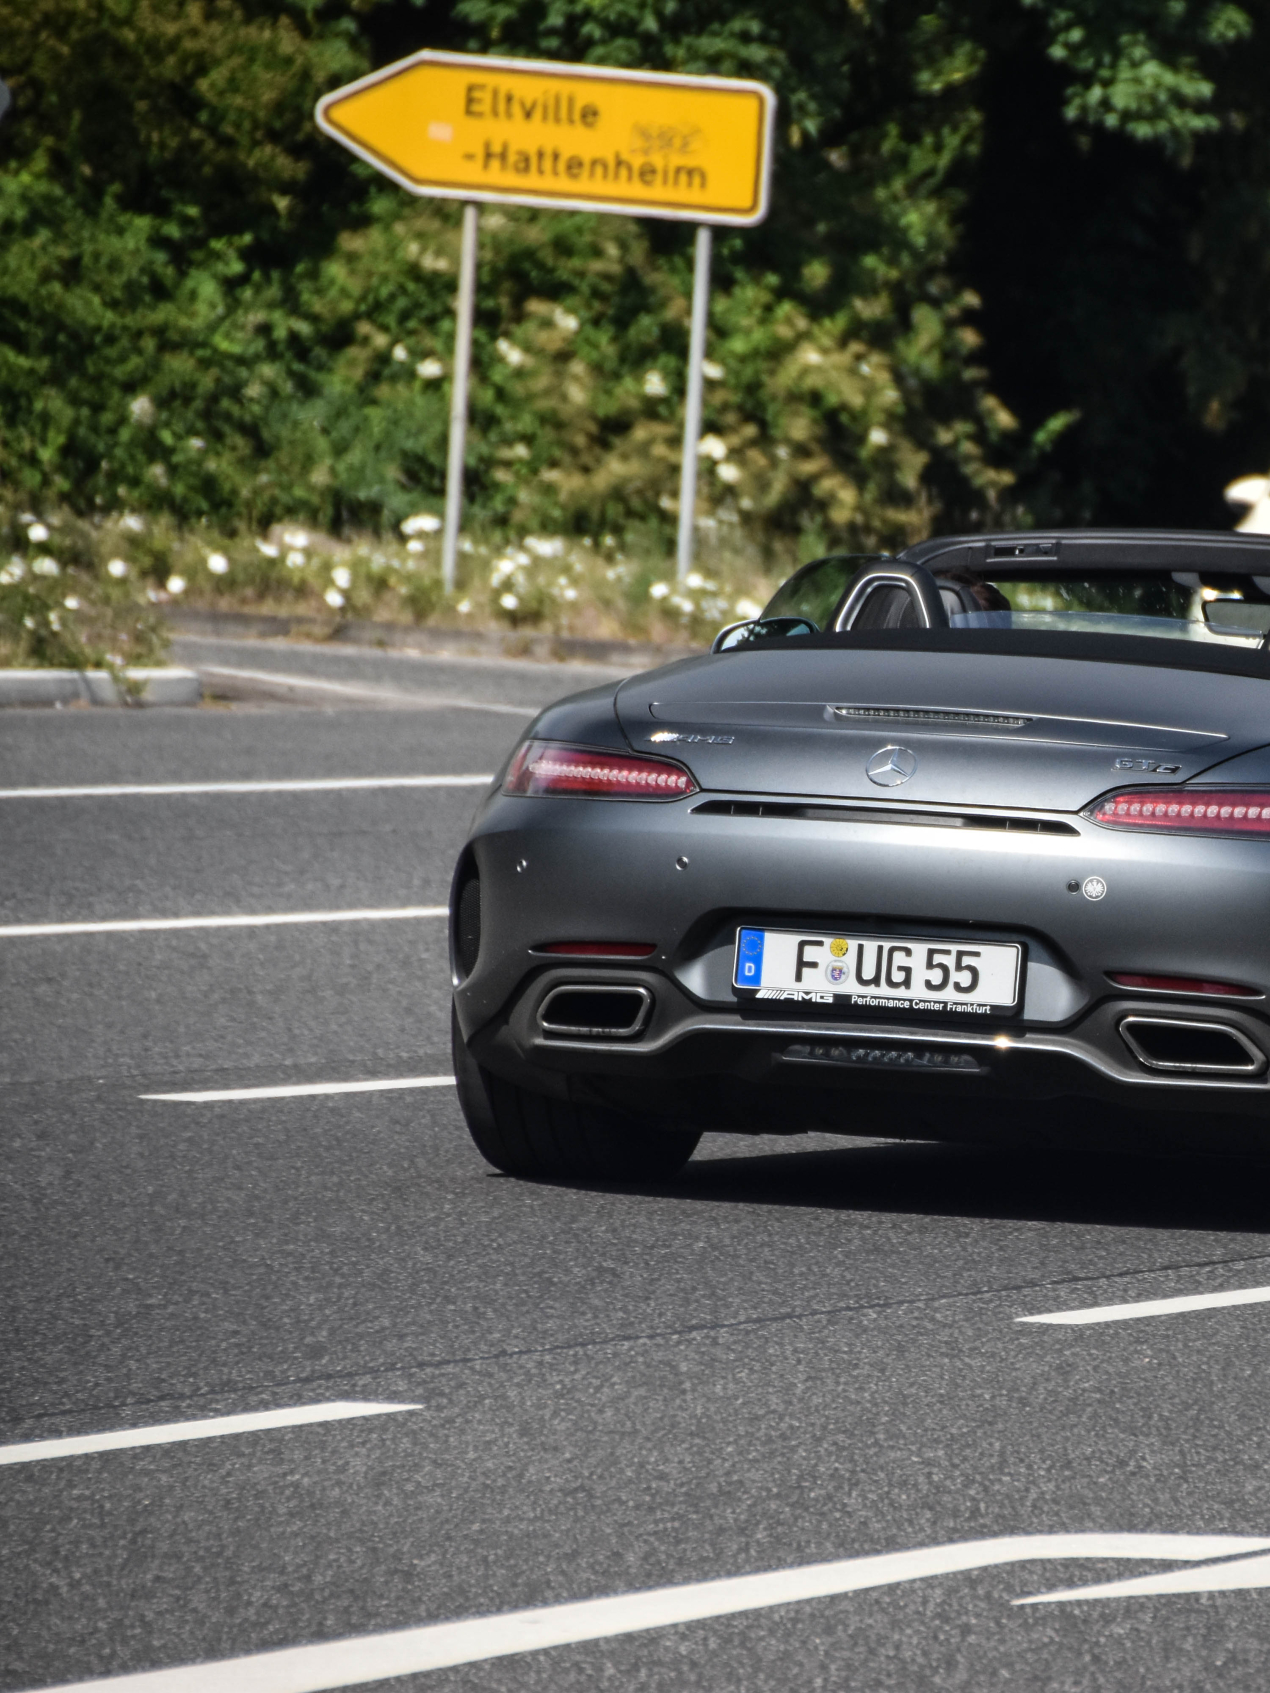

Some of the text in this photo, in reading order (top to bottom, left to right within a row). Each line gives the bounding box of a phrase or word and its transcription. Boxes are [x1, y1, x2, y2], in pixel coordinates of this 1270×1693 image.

[464, 84, 600, 128] Eltville
[463, 140, 707, 190] -Hattenheim
[744, 962, 755, 976] D
[795, 939, 981, 994] F UG 55
[780, 990, 834, 1003] AMG
[851, 995, 991, 1014] Performance Center Frankfurt
